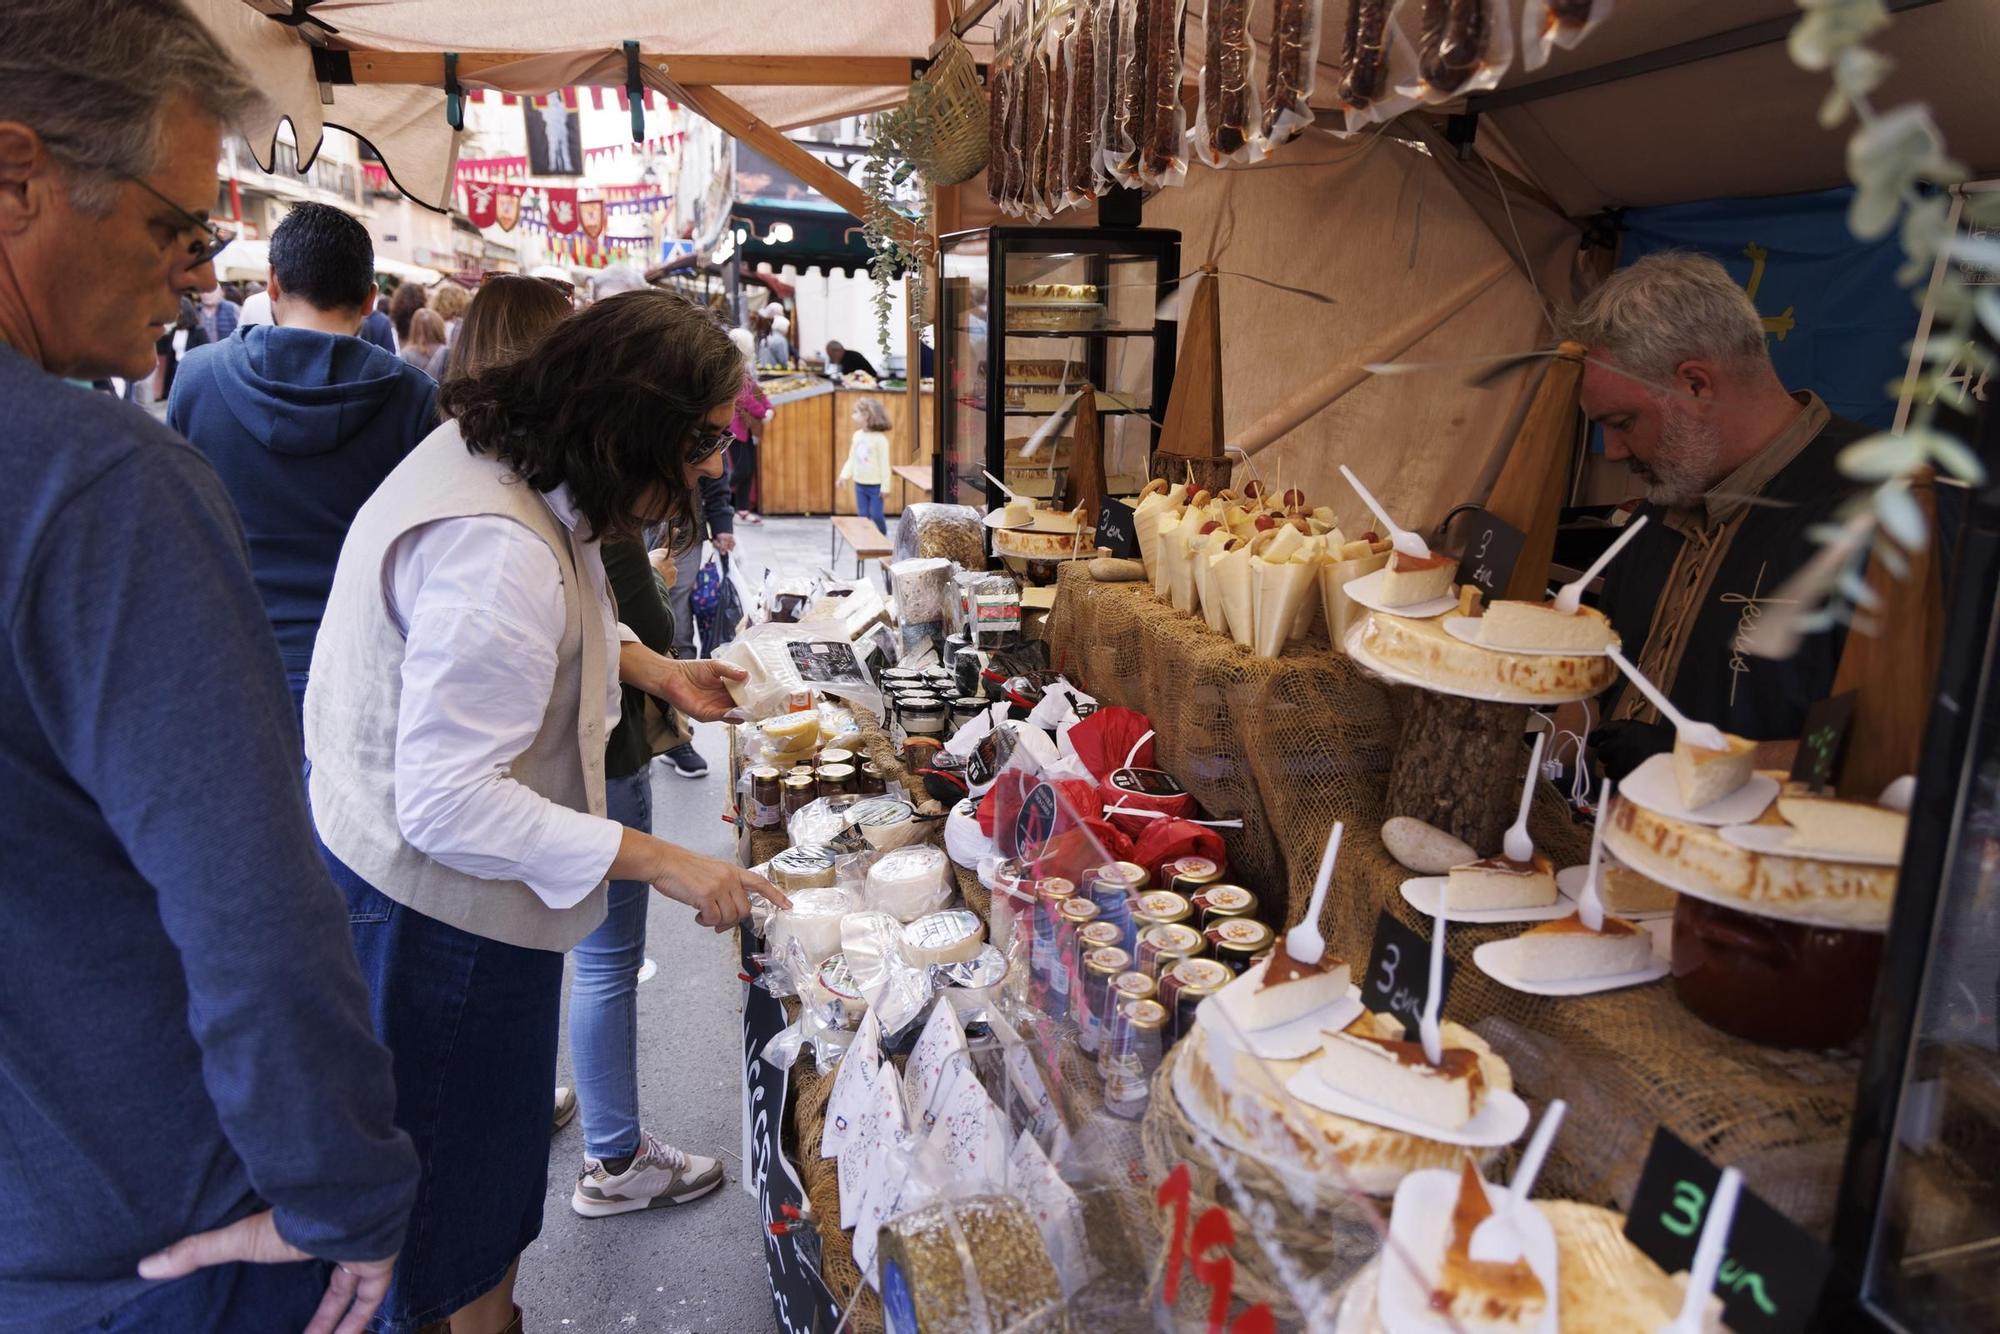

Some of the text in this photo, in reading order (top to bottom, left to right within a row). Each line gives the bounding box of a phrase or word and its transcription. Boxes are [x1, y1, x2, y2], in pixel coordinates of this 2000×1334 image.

[1100, 508, 1110, 531] 3
[1475, 529, 1493, 559] 3
[1376, 943, 1400, 993] 3
[1660, 1179, 1707, 1237] 3
